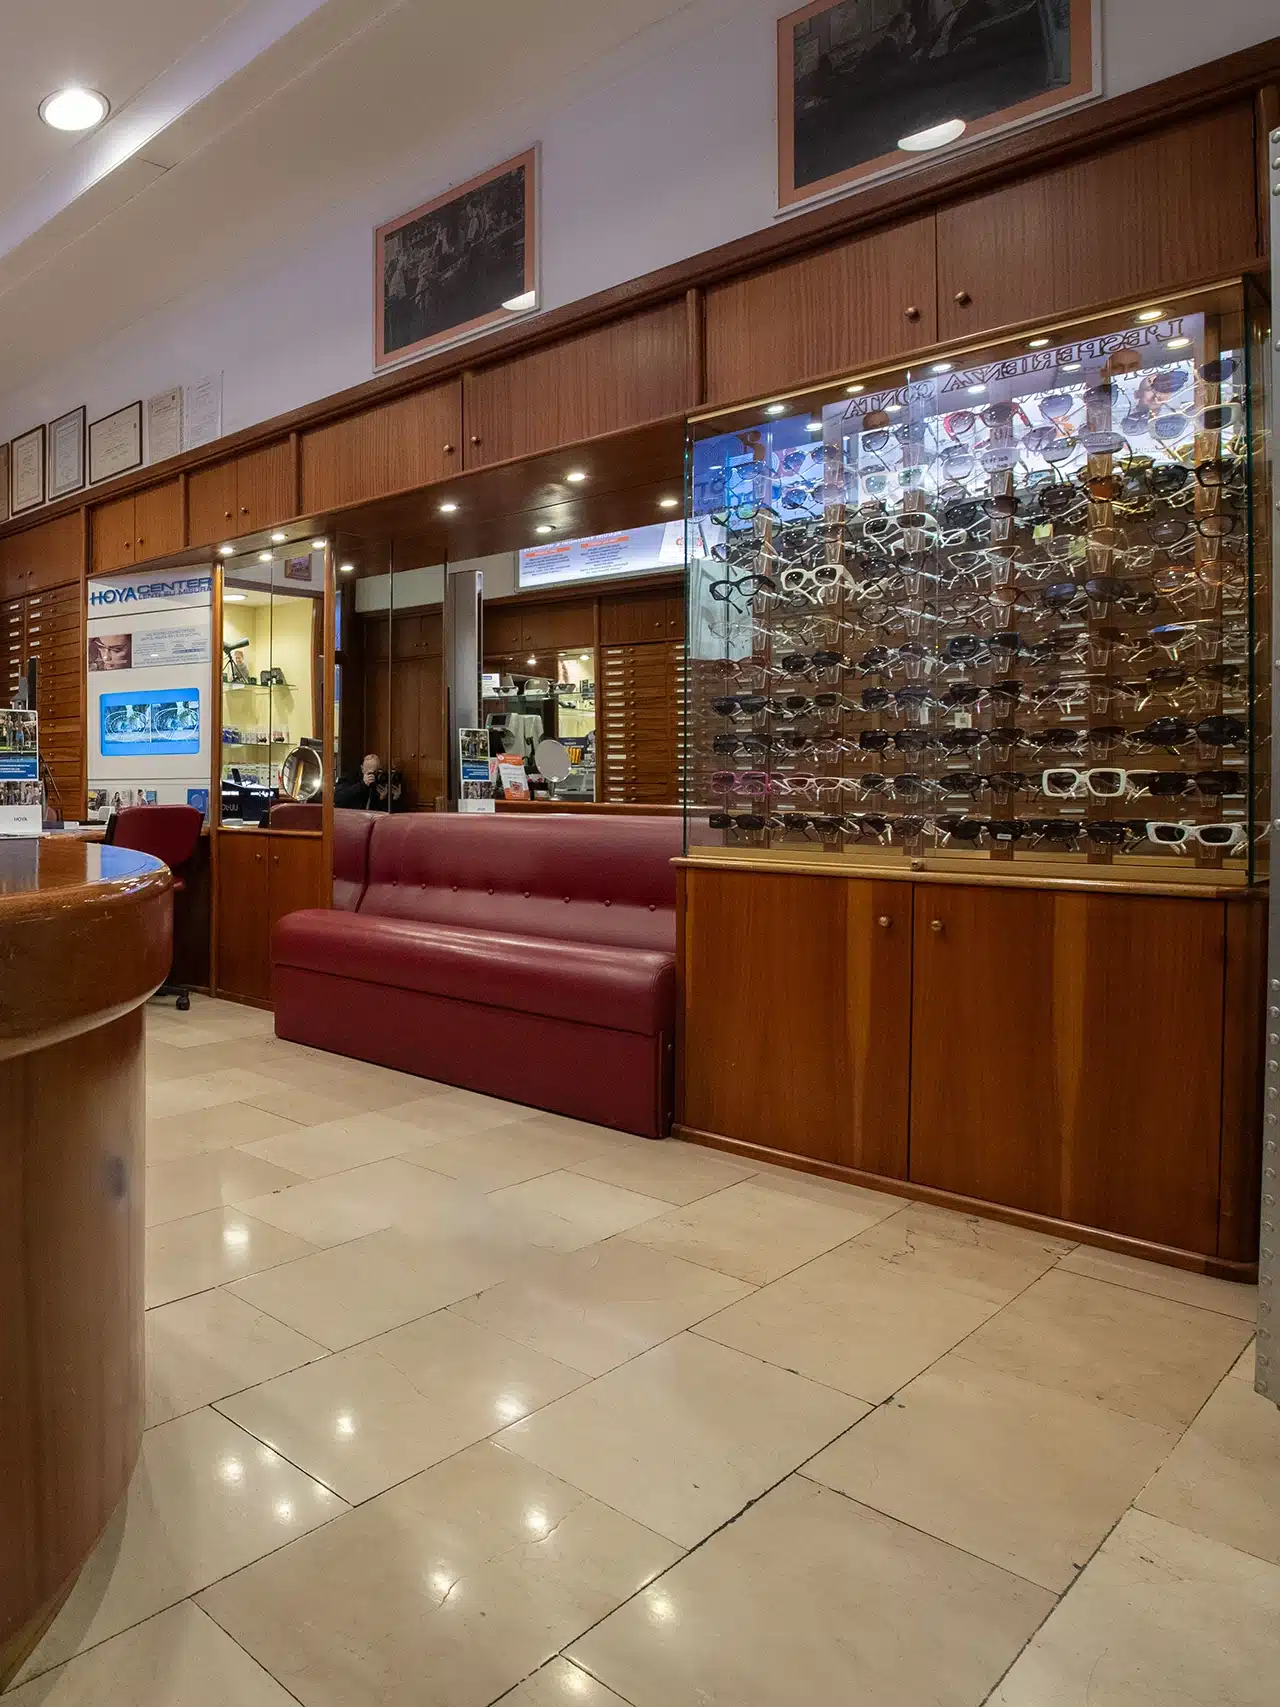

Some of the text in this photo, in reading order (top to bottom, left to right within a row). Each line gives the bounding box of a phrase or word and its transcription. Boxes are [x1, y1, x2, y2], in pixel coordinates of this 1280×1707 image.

[89, 577, 213, 606] HOYA CENTER
[138, 585, 213, 600] LENTI SU MISURA
